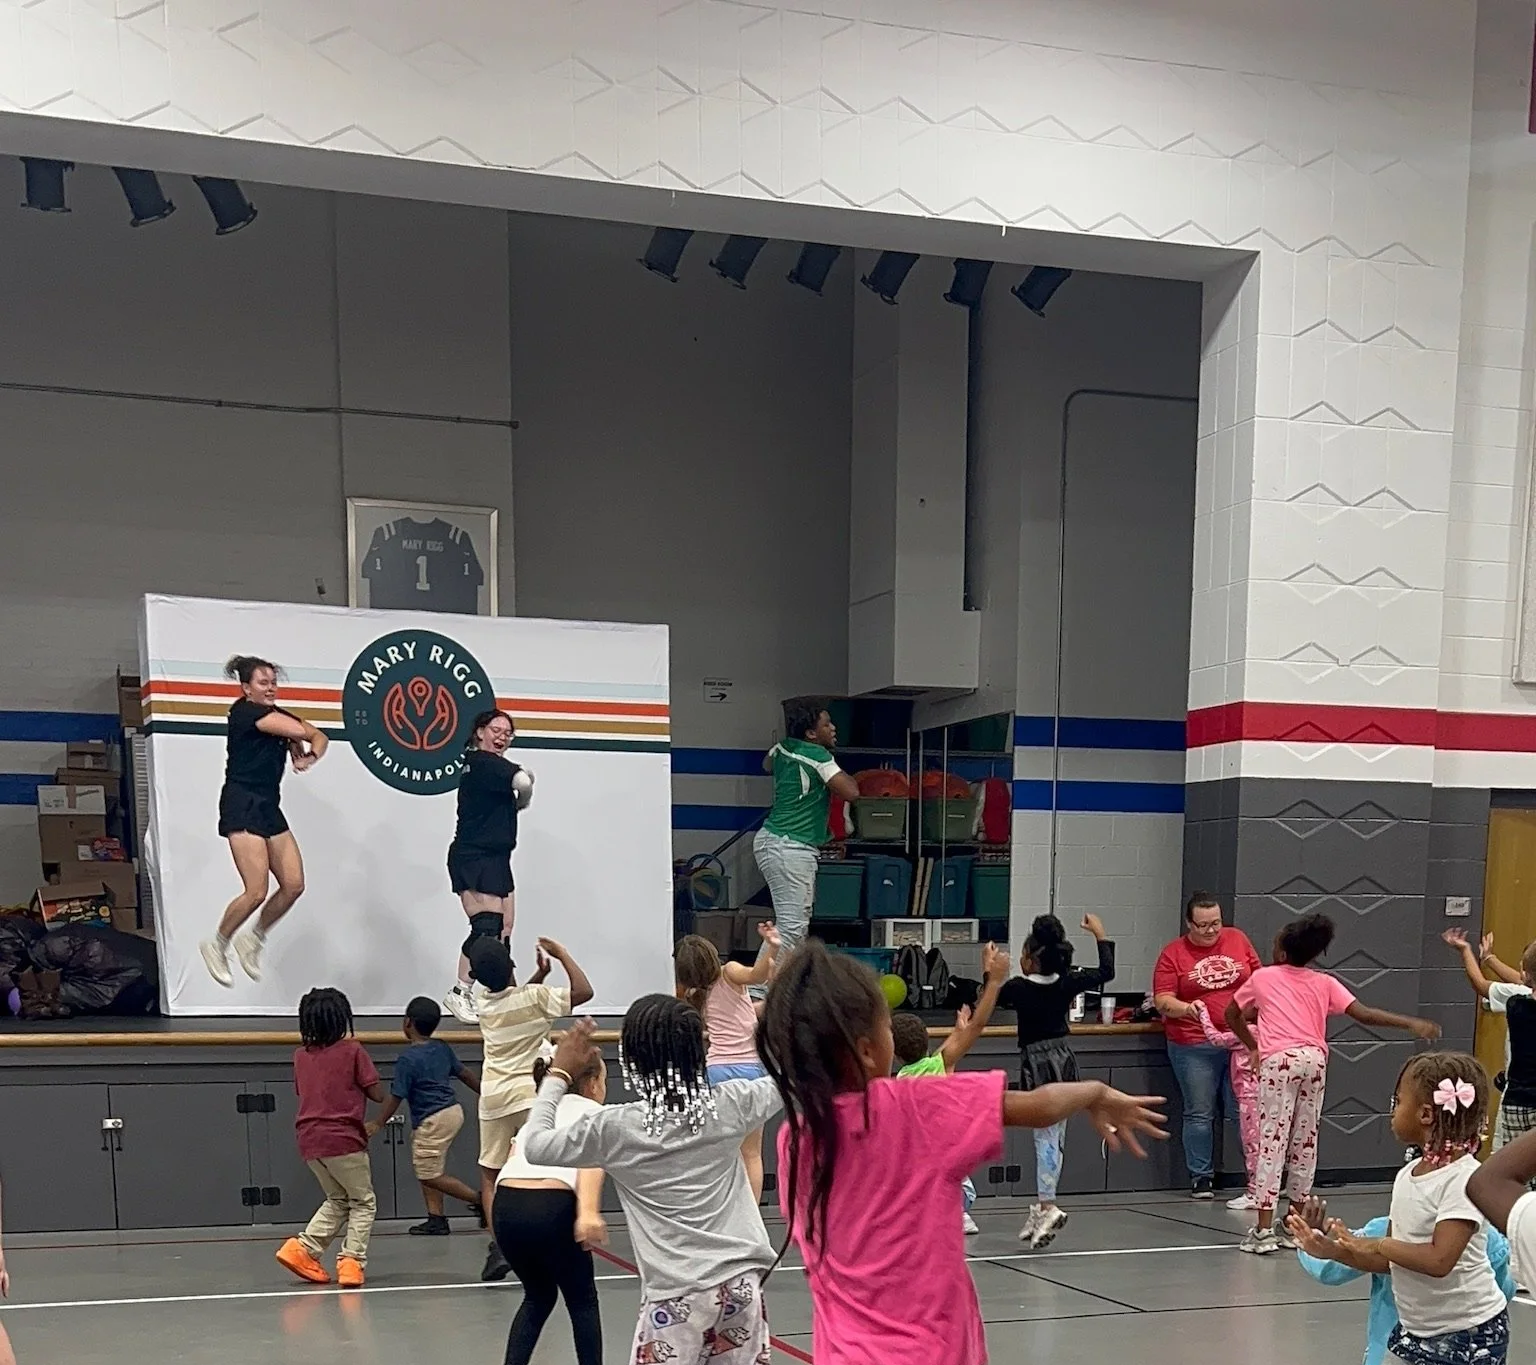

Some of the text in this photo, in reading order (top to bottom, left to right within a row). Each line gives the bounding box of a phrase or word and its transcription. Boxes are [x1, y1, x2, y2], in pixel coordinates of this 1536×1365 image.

[402, 539, 444, 553] MARY RIGG
[375, 558, 382, 571] 1
[416, 555, 430, 591] 1
[463, 563, 470, 575] 1
[357, 641, 482, 699] MARY RIGG
[368, 741, 467, 782] INDIANAPOLI
